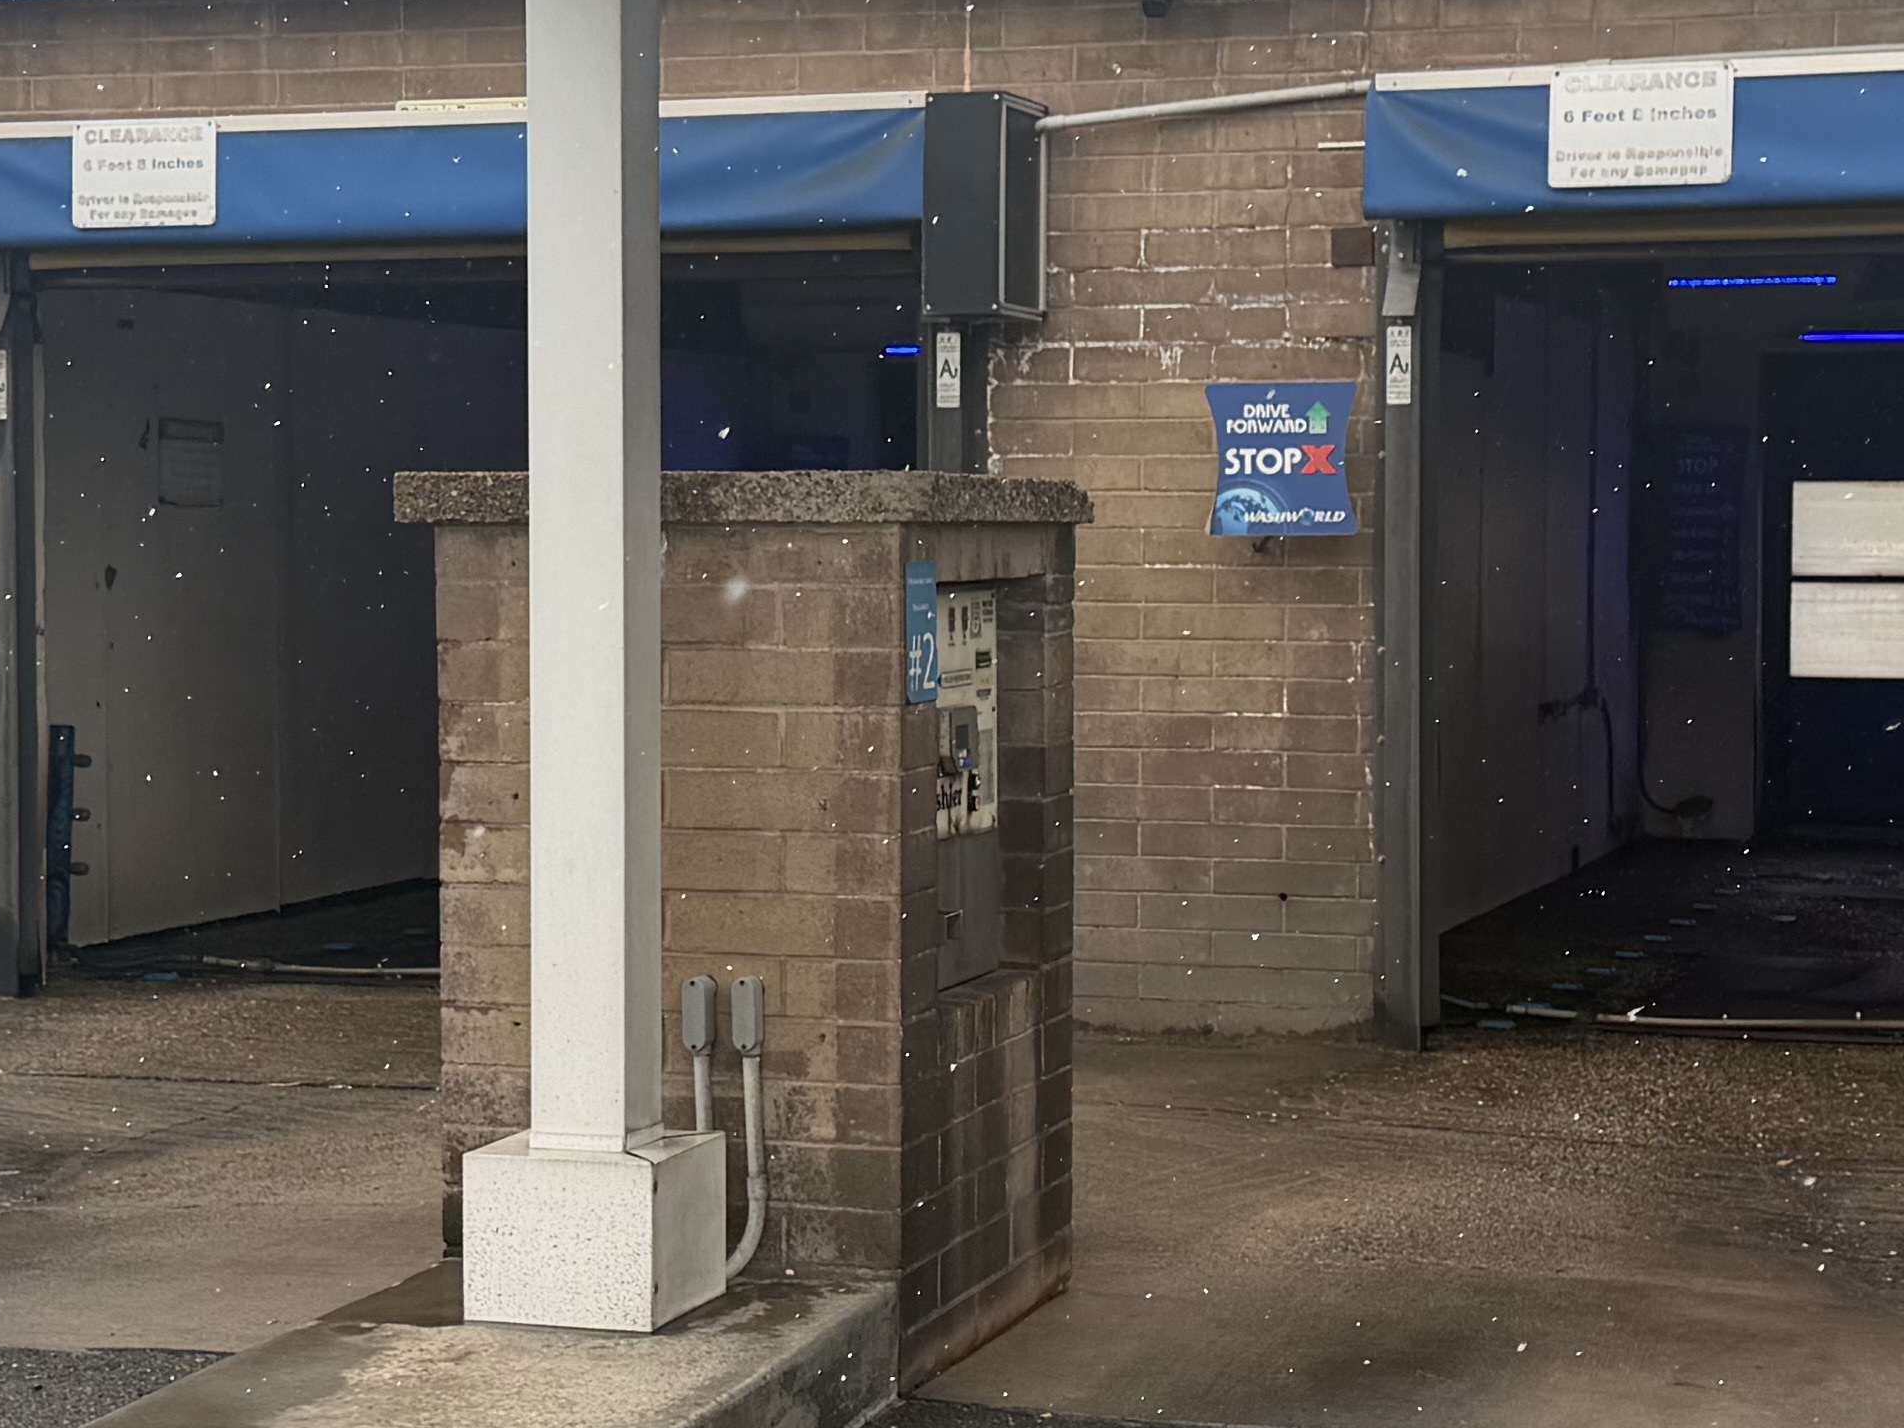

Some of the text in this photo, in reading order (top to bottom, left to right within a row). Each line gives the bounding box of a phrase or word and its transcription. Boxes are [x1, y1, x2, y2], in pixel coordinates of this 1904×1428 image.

[151, 157, 204, 170] Inches
[1243, 403, 1290, 418] DRIVE
[1226, 419, 1307, 434] FORWARD
[1224, 447, 1302, 475] STOP
[909, 632, 935, 692] #2
